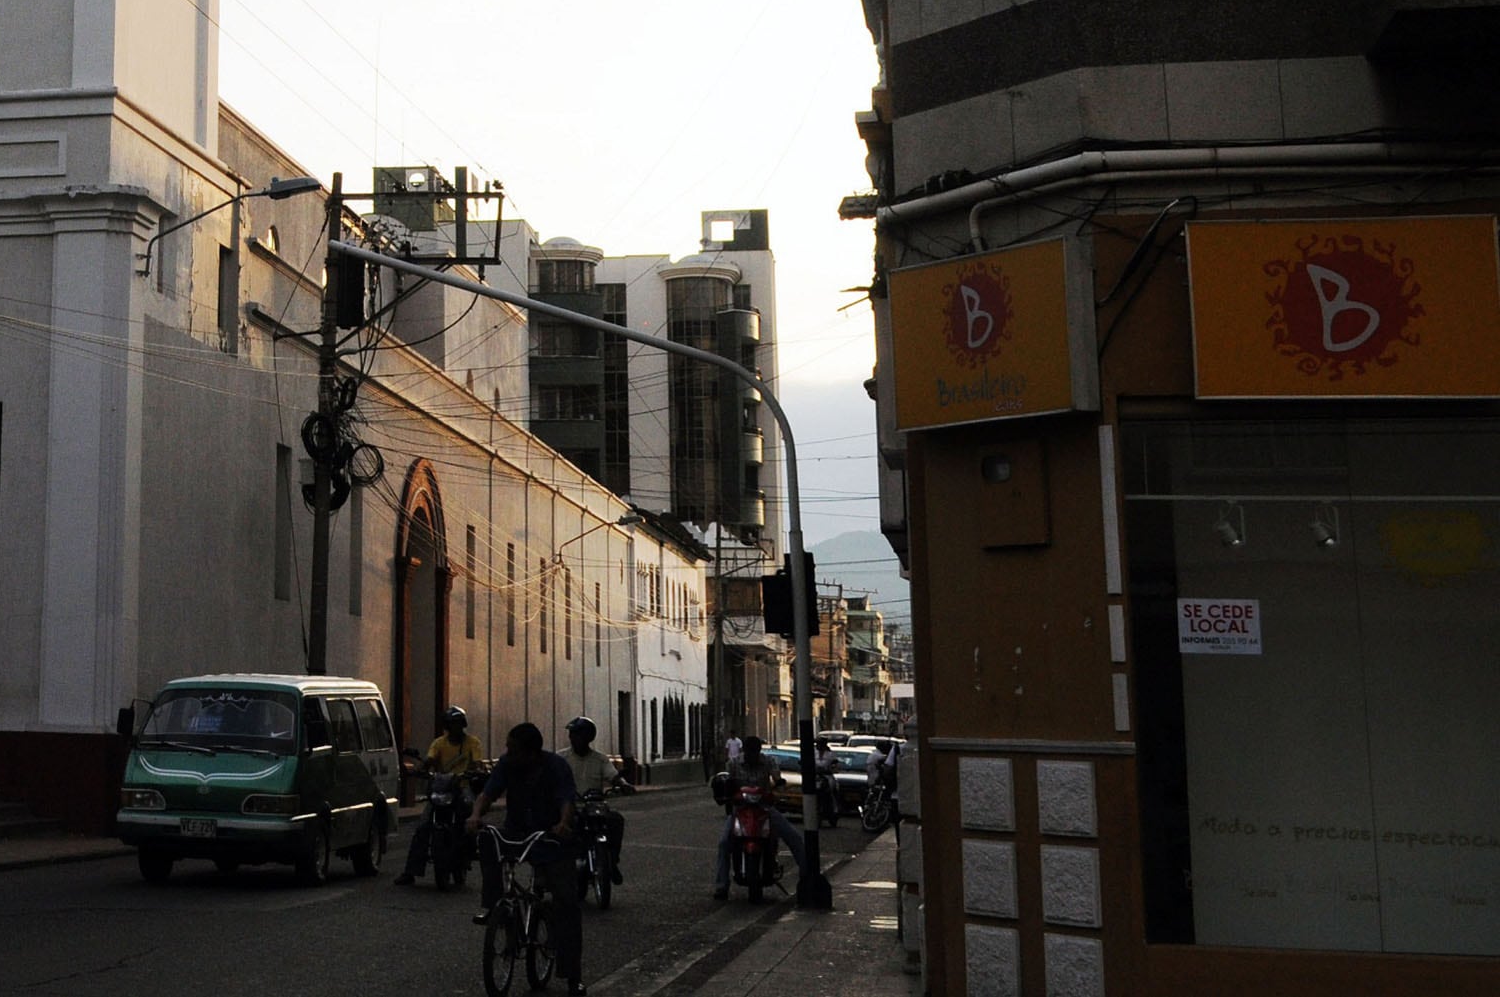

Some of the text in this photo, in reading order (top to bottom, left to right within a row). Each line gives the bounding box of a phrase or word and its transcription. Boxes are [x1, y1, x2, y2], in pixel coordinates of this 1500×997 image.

[960, 284, 994, 349] B
[1307, 263, 1380, 352] B
[1183, 604, 1253, 619] SE CEDE
[1190, 619, 1249, 634] LOCAL
[1181, 636, 1221, 645] INFORMES
[1199, 817, 1256, 835] Moda
[1267, 824, 1282, 837] a
[1292, 825, 1372, 843] precios
